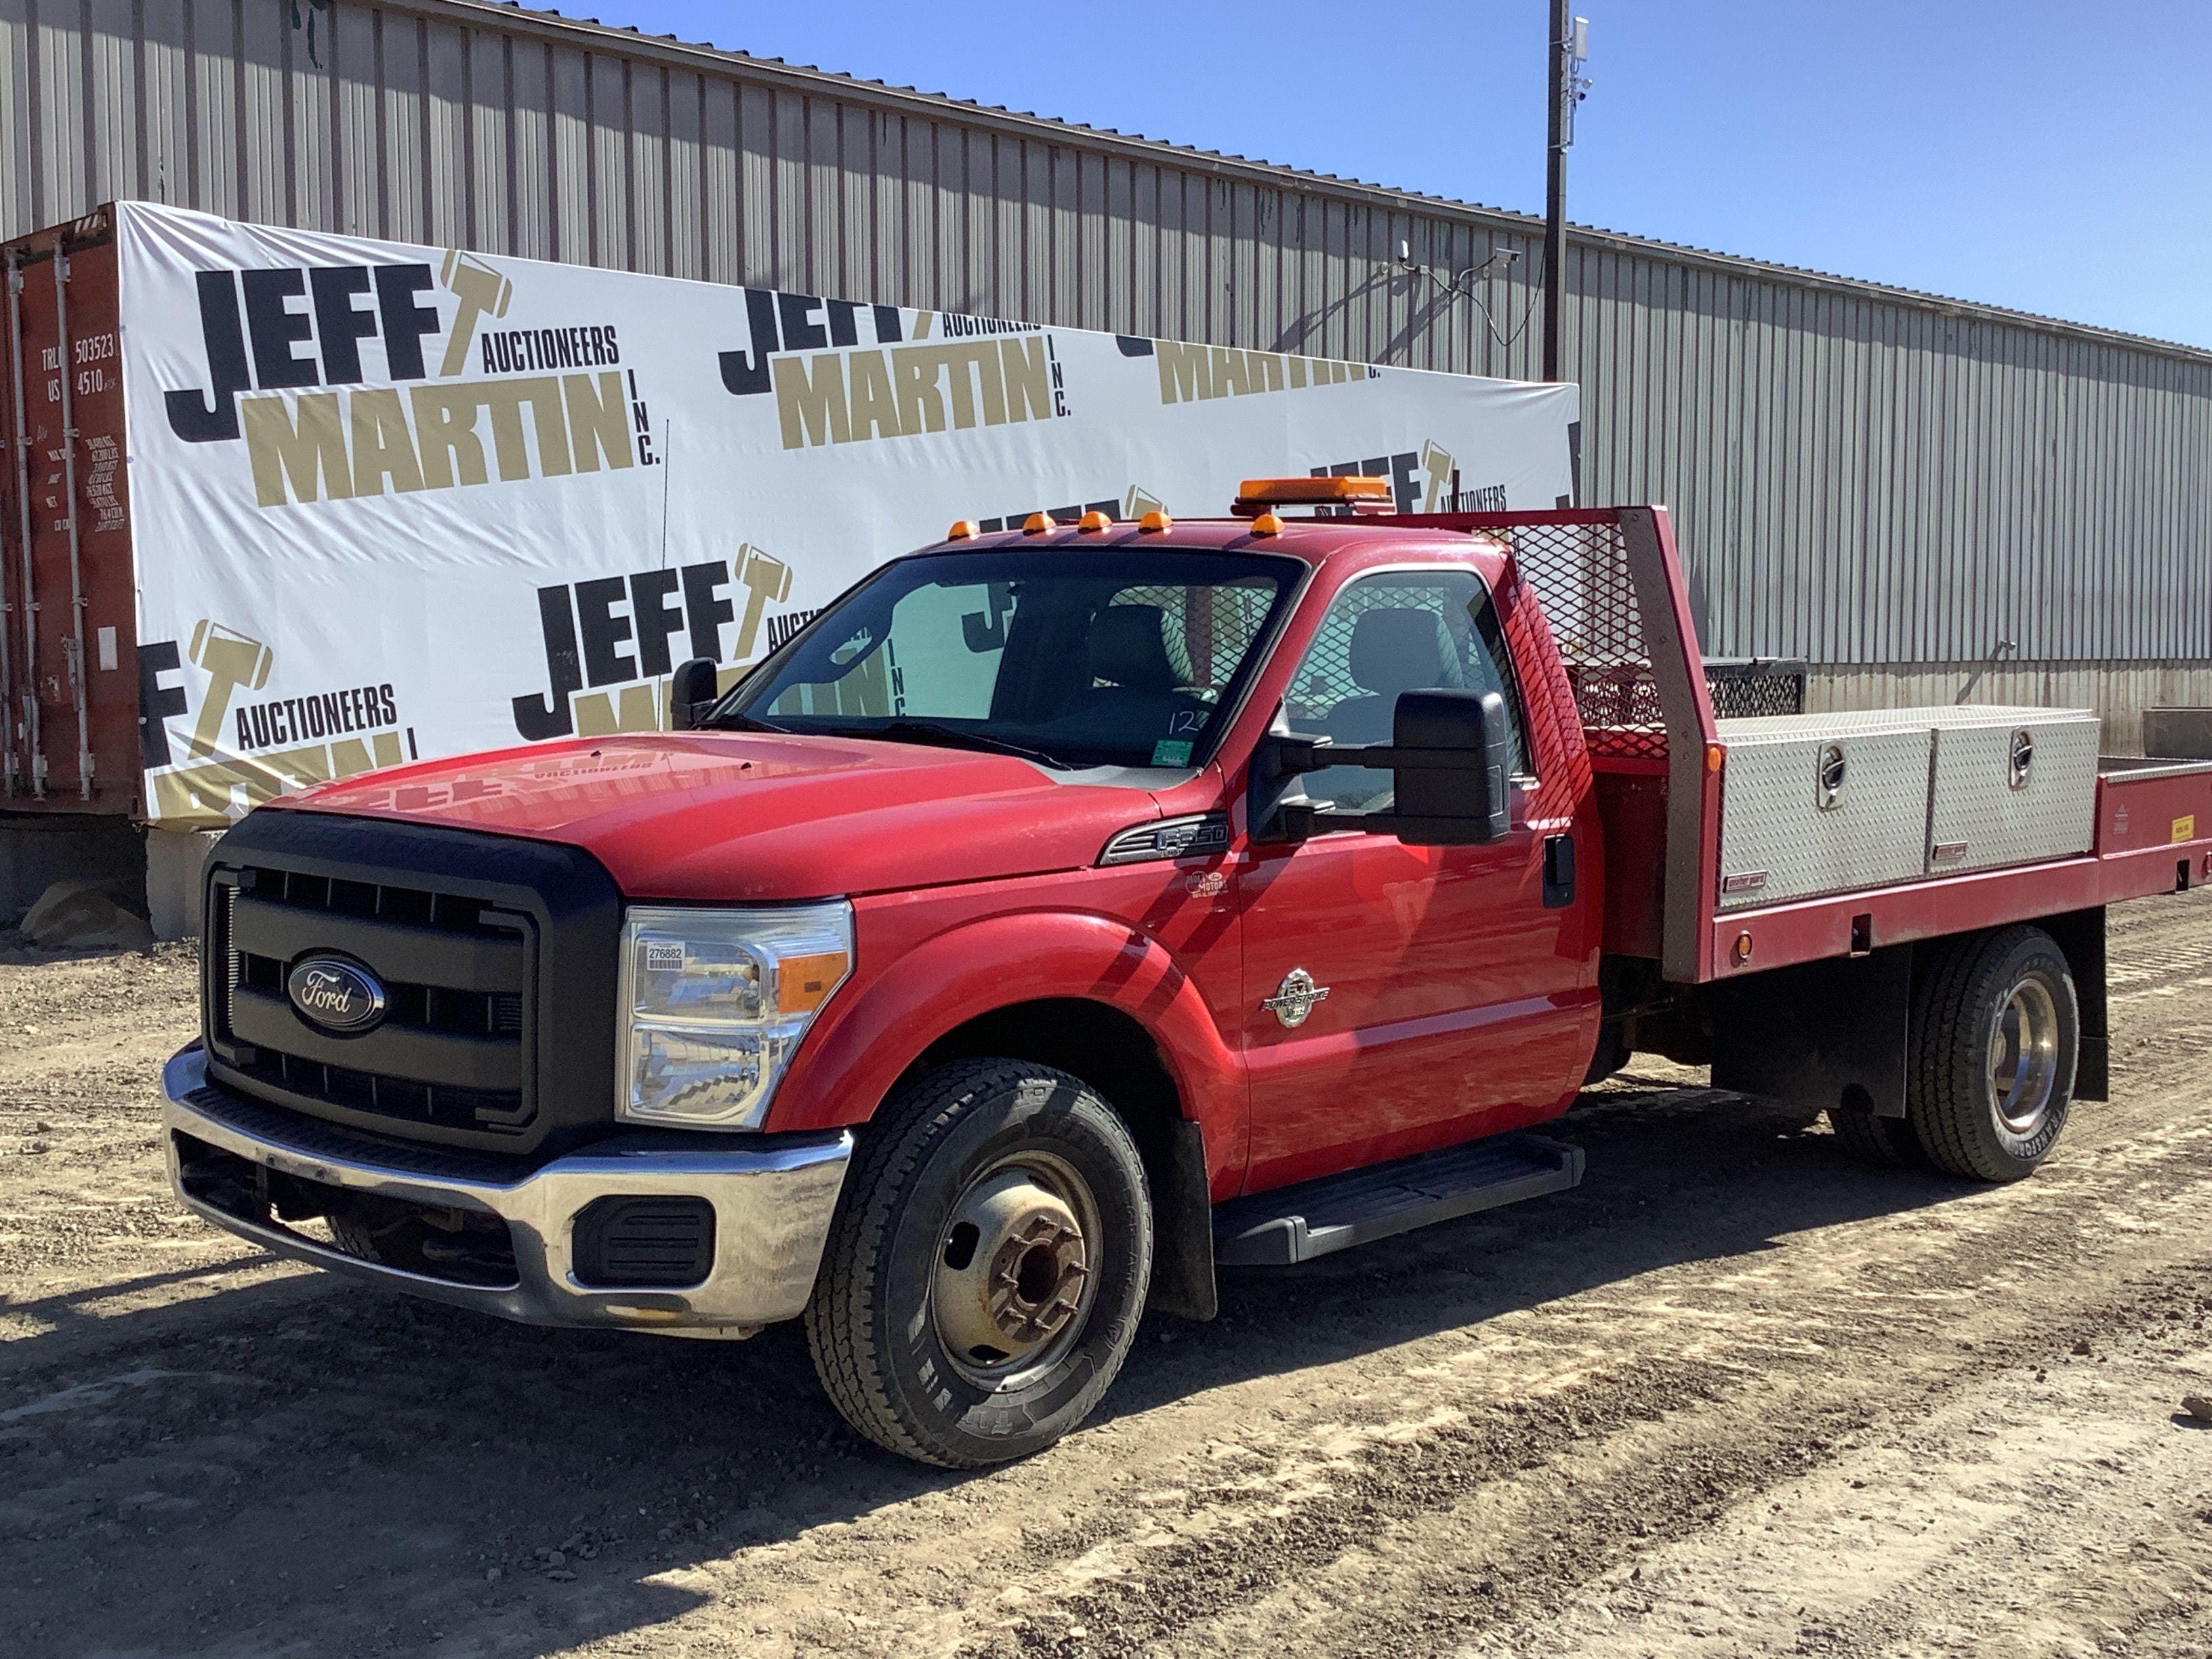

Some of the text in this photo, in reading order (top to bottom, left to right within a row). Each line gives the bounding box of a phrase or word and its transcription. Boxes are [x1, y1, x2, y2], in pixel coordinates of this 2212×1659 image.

[75, 333, 114, 365] 503523
[163, 264, 441, 443] JEFF
[480, 325, 619, 374] AUCTIONEERS
[47, 378, 60, 403] US
[77, 368, 103, 395] 4510
[771, 335, 1052, 451] MARTIN
[1047, 334, 1071, 417] INC.
[240, 371, 634, 508] MARTIN
[628, 369, 661, 466] INC.
[1440, 484, 1507, 513] ATIONEERS
[512, 560, 735, 742] JEFF
[235, 683, 398, 751] AUCTIONEERS
[1168, 710, 1199, 735] 12
[649, 948, 682, 960] 276882
[302, 970, 352, 1013] Ford
[2009, 1107, 2063, 1158] TRANSFOR
